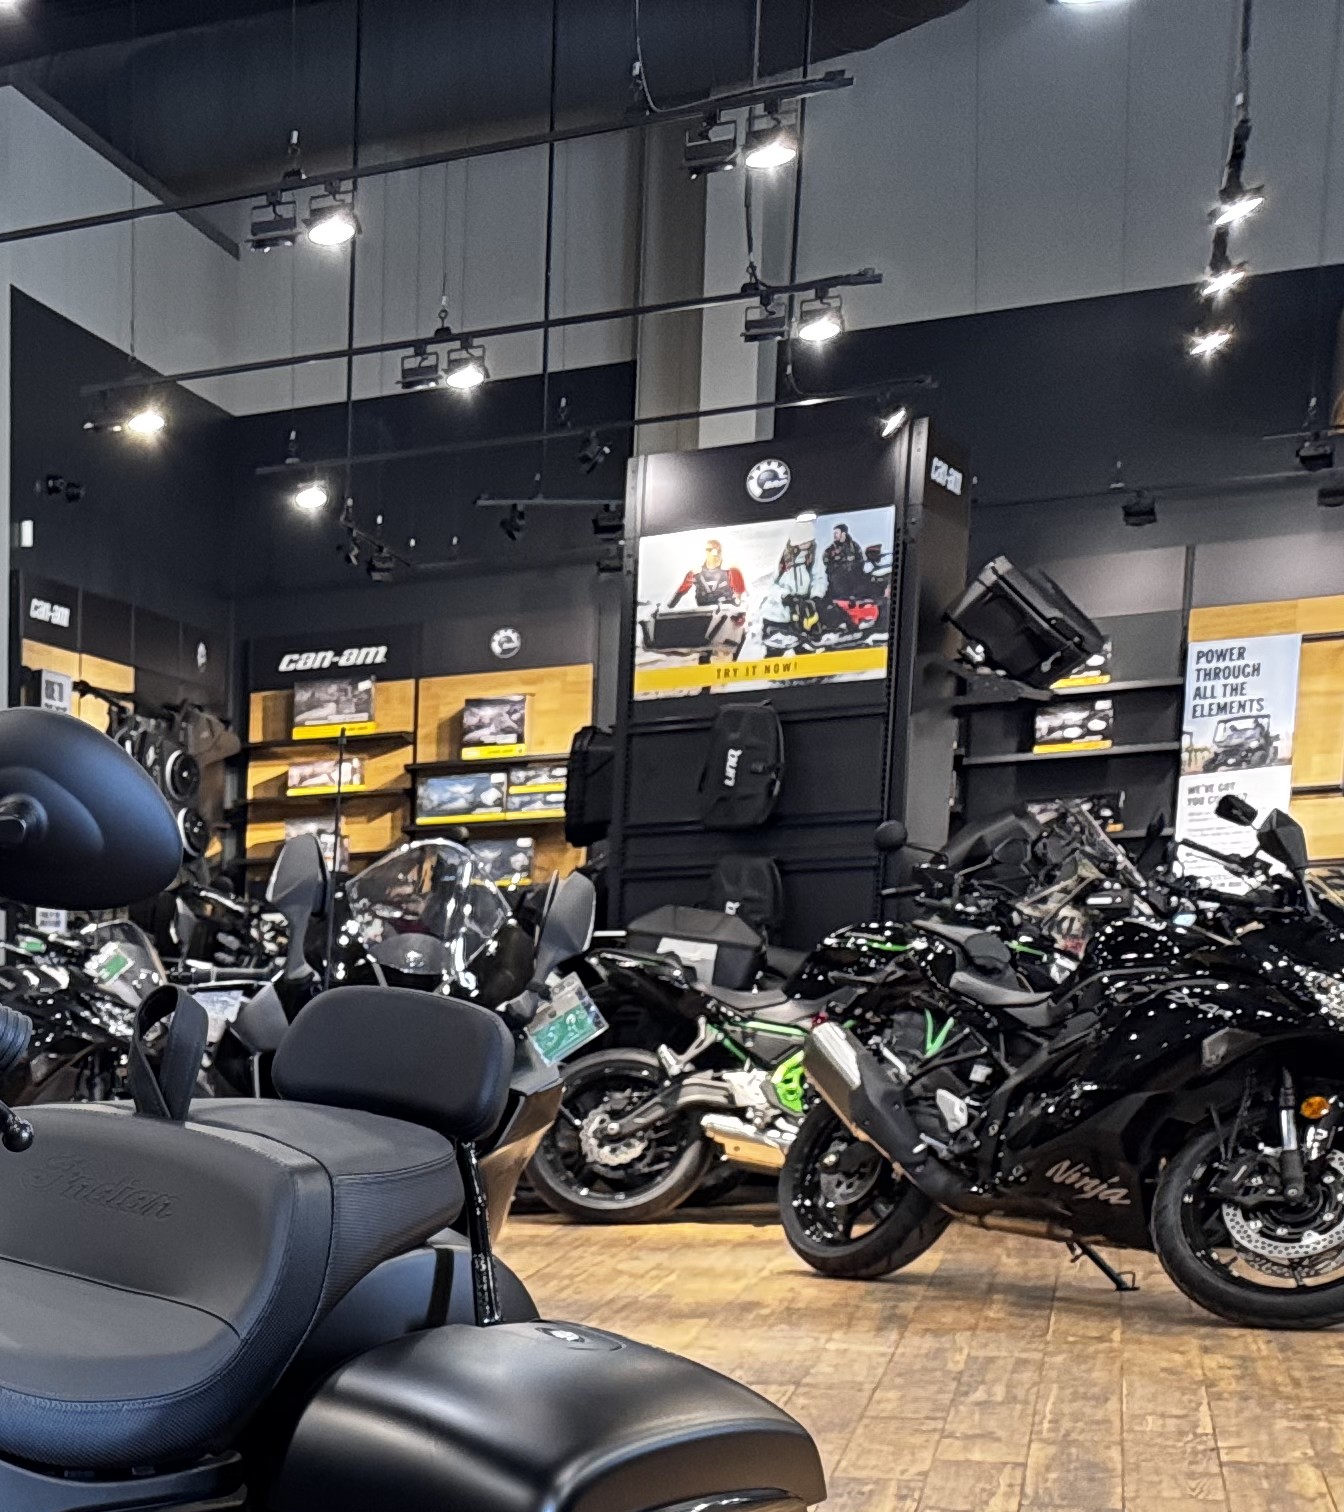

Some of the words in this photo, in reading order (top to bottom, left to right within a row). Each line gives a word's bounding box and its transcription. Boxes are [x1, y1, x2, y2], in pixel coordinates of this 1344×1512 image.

[278, 645, 388, 672] can-am
[1195, 646, 1247, 665] POWER
[716, 667, 739, 679] TRY
[745, 665, 757, 677] IT
[764, 661, 798, 674] NOW!
[1194, 662, 1261, 683] THROUGH
[1192, 684, 1217, 701] ALL
[1222, 681, 1248, 698] THE
[1191, 698, 1265, 719] ELEMENTS
[1044, 1159, 1131, 1205] Ninja
